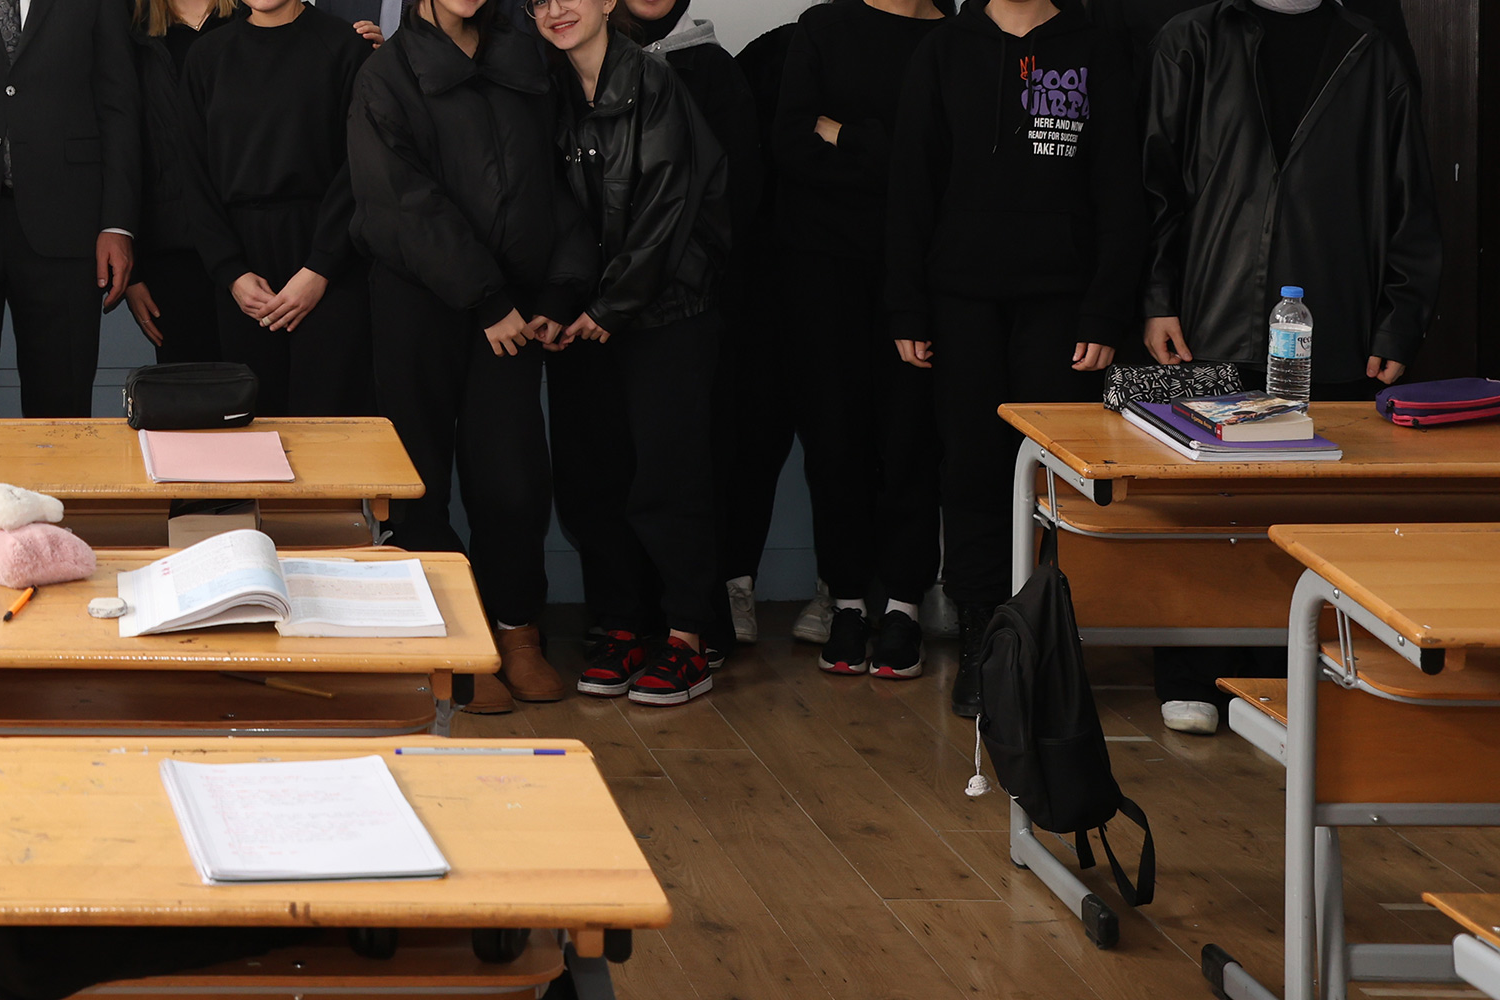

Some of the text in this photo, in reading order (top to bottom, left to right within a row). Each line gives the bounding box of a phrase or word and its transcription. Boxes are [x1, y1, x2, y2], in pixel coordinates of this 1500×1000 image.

[1034, 117, 1084, 132] HERE AND NOW
[1028, 130, 1047, 139] READY
[1048, 131, 1060, 141] FOR
[1033, 142, 1055, 155] TAKE
[1056, 143, 1065, 156] IT
